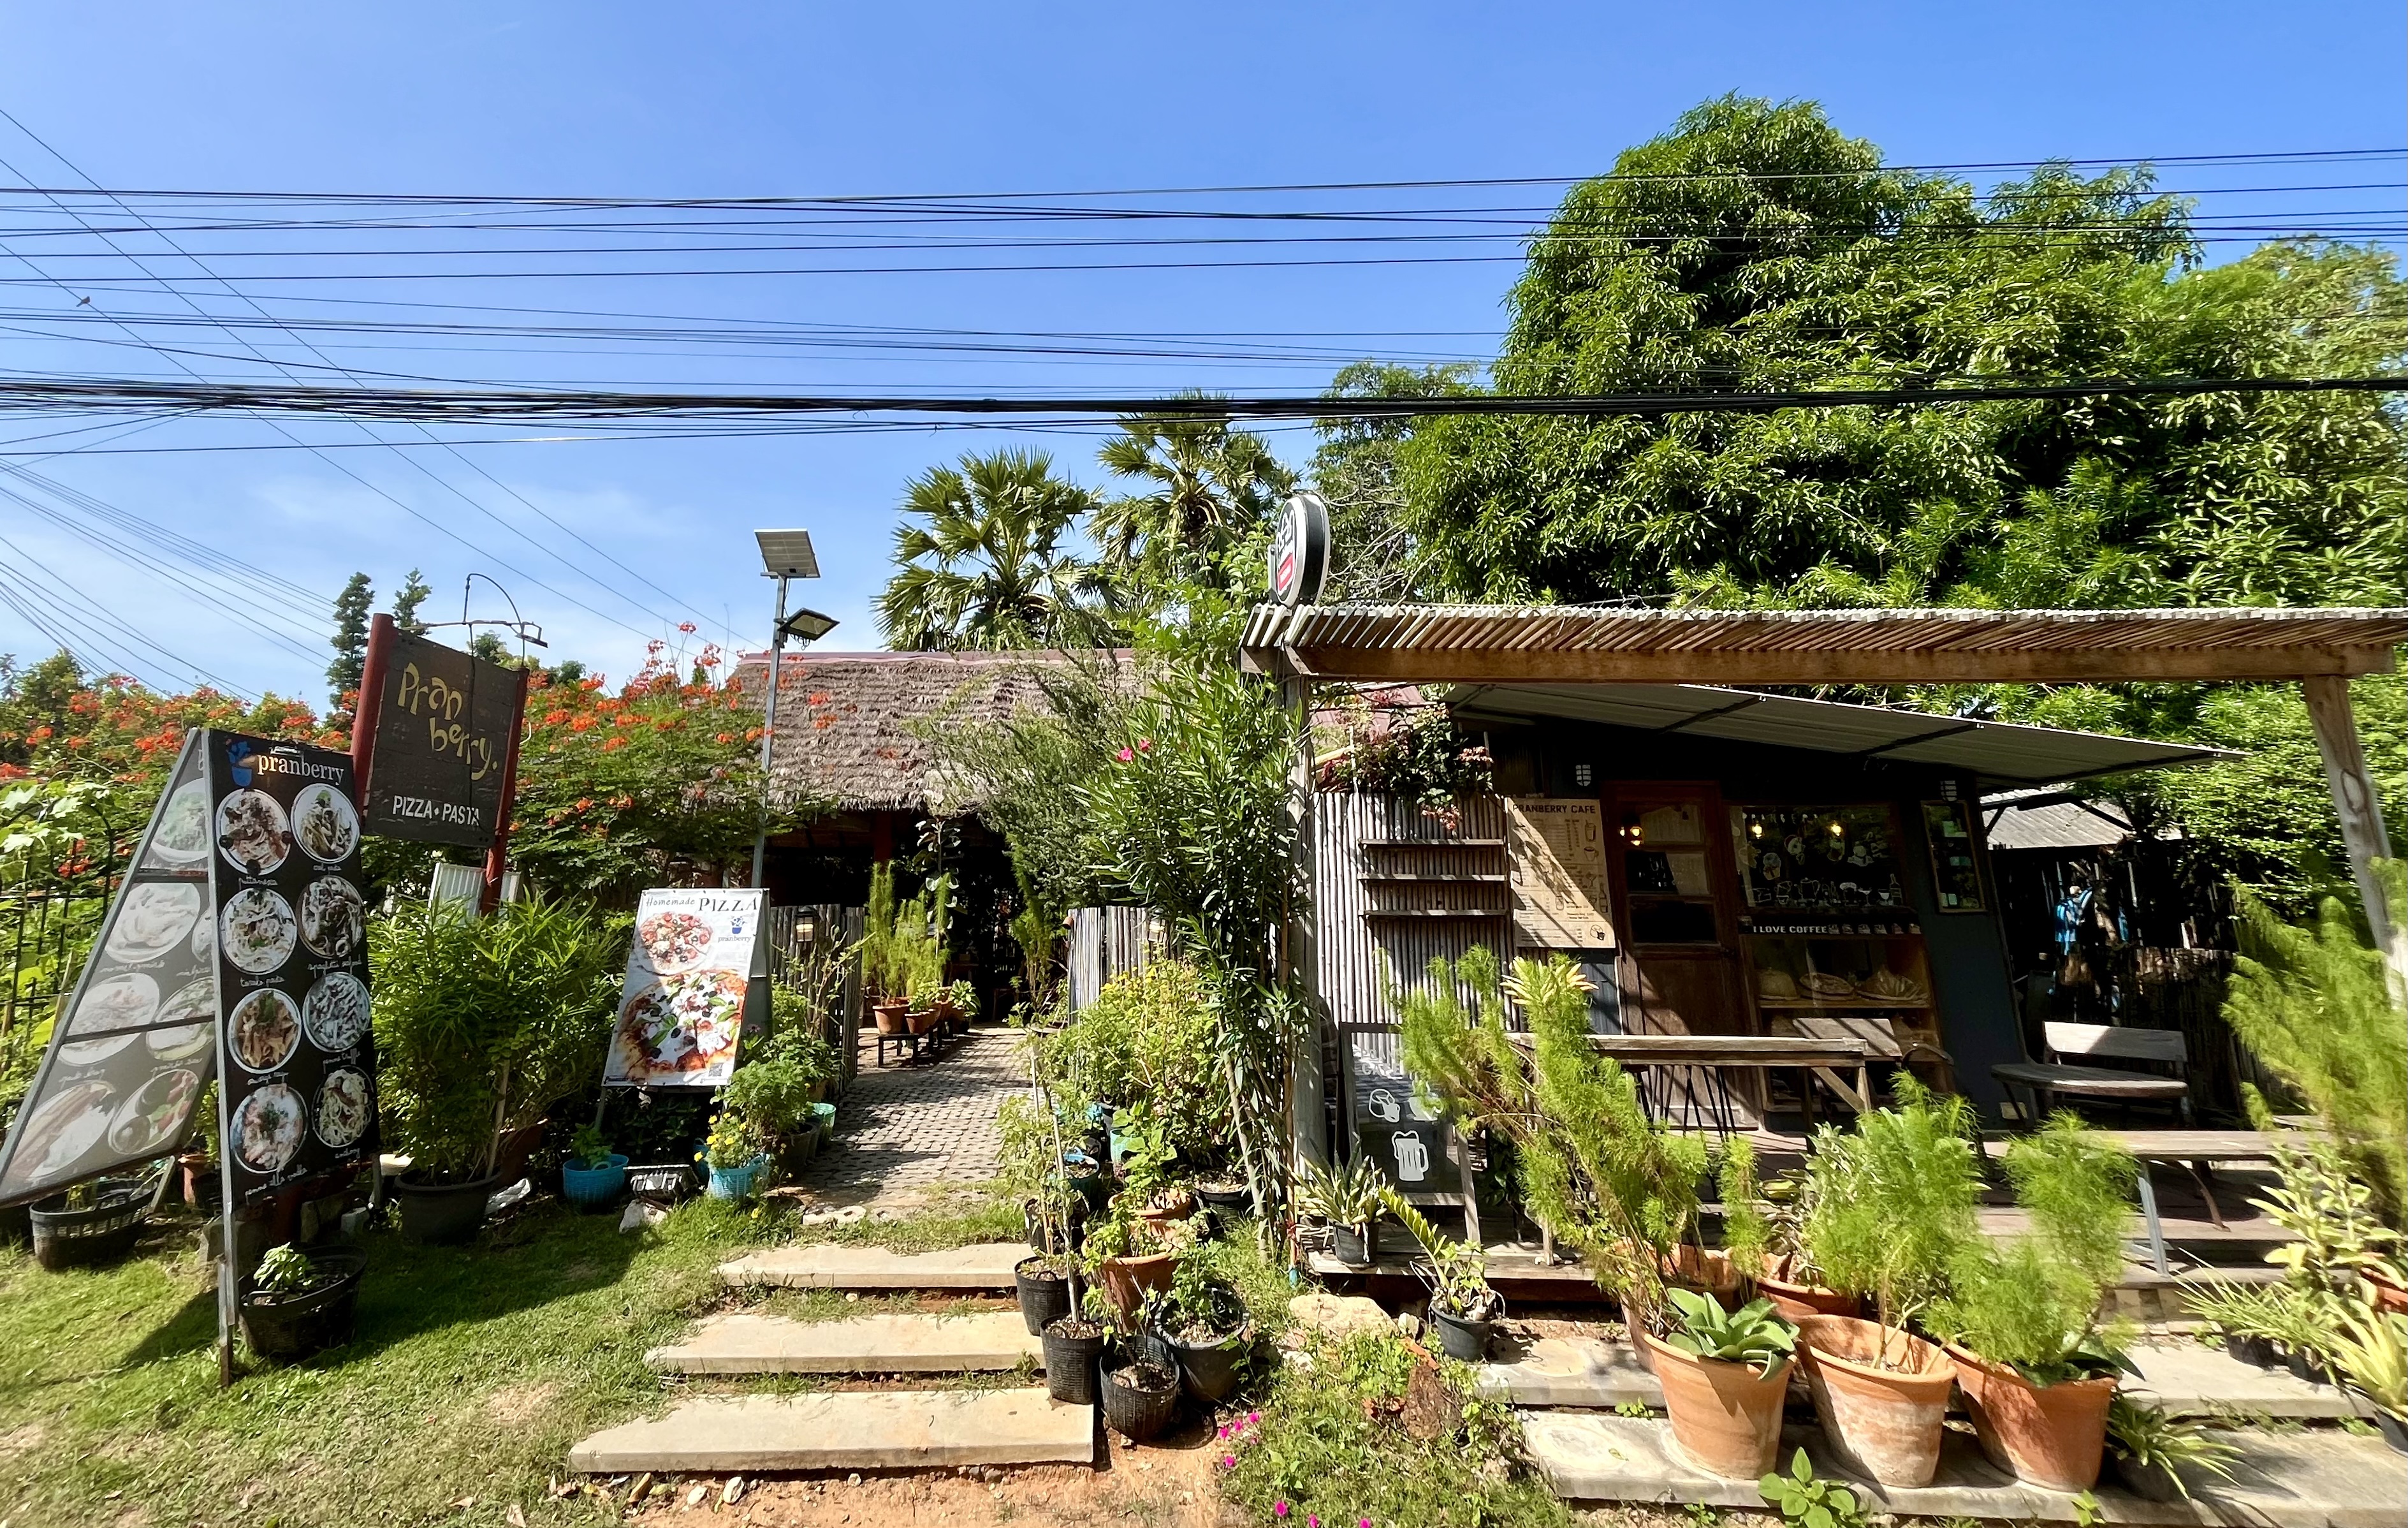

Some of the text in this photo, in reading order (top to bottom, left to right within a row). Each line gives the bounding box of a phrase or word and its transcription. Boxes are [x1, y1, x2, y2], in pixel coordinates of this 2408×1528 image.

[397, 662, 462, 720] Pran
[257, 754, 344, 785] pranberry
[392, 795, 479, 826] PIZZA PASTA
[1512, 804, 1596, 814] PRANBERRY CAFE
[645, 897, 757, 912] Homemade PIZZA
